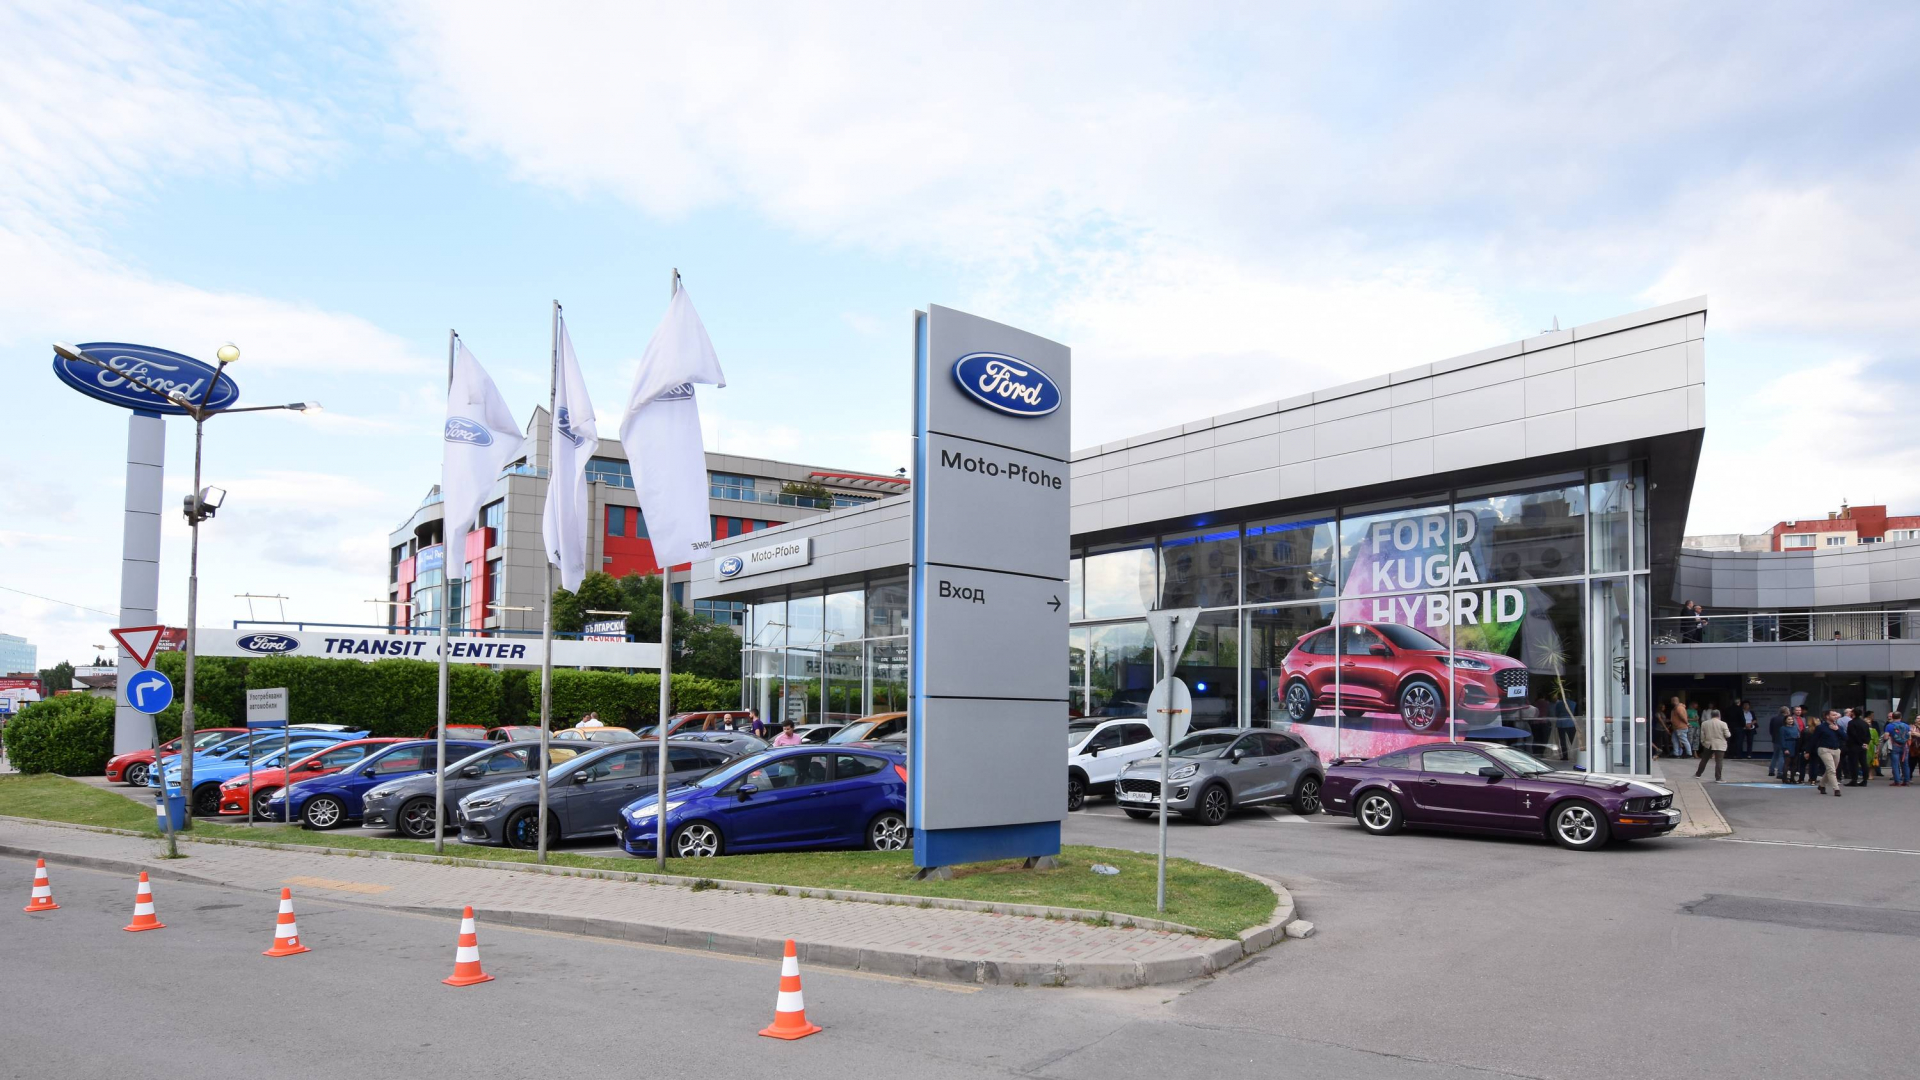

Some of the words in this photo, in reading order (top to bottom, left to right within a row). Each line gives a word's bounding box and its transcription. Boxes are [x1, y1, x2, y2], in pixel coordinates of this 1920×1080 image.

[97, 355, 205, 401] Ford
[978, 361, 1043, 405] Ford
[445, 420, 481, 440] Ford
[941, 449, 1062, 490] Moto-Pfohe
[1372, 511, 1476, 554] FORD
[751, 544, 800, 562] Moto-Pfohe
[1372, 551, 1479, 592] KUGA
[939, 580, 985, 604] Вход
[1372, 588, 1524, 628] HYBRID
[250, 635, 287, 650] Ford
[324, 638, 427, 656] TRANSIT
[249, 691, 283, 701] Употребявани
[249, 702, 278, 710] автомобили
